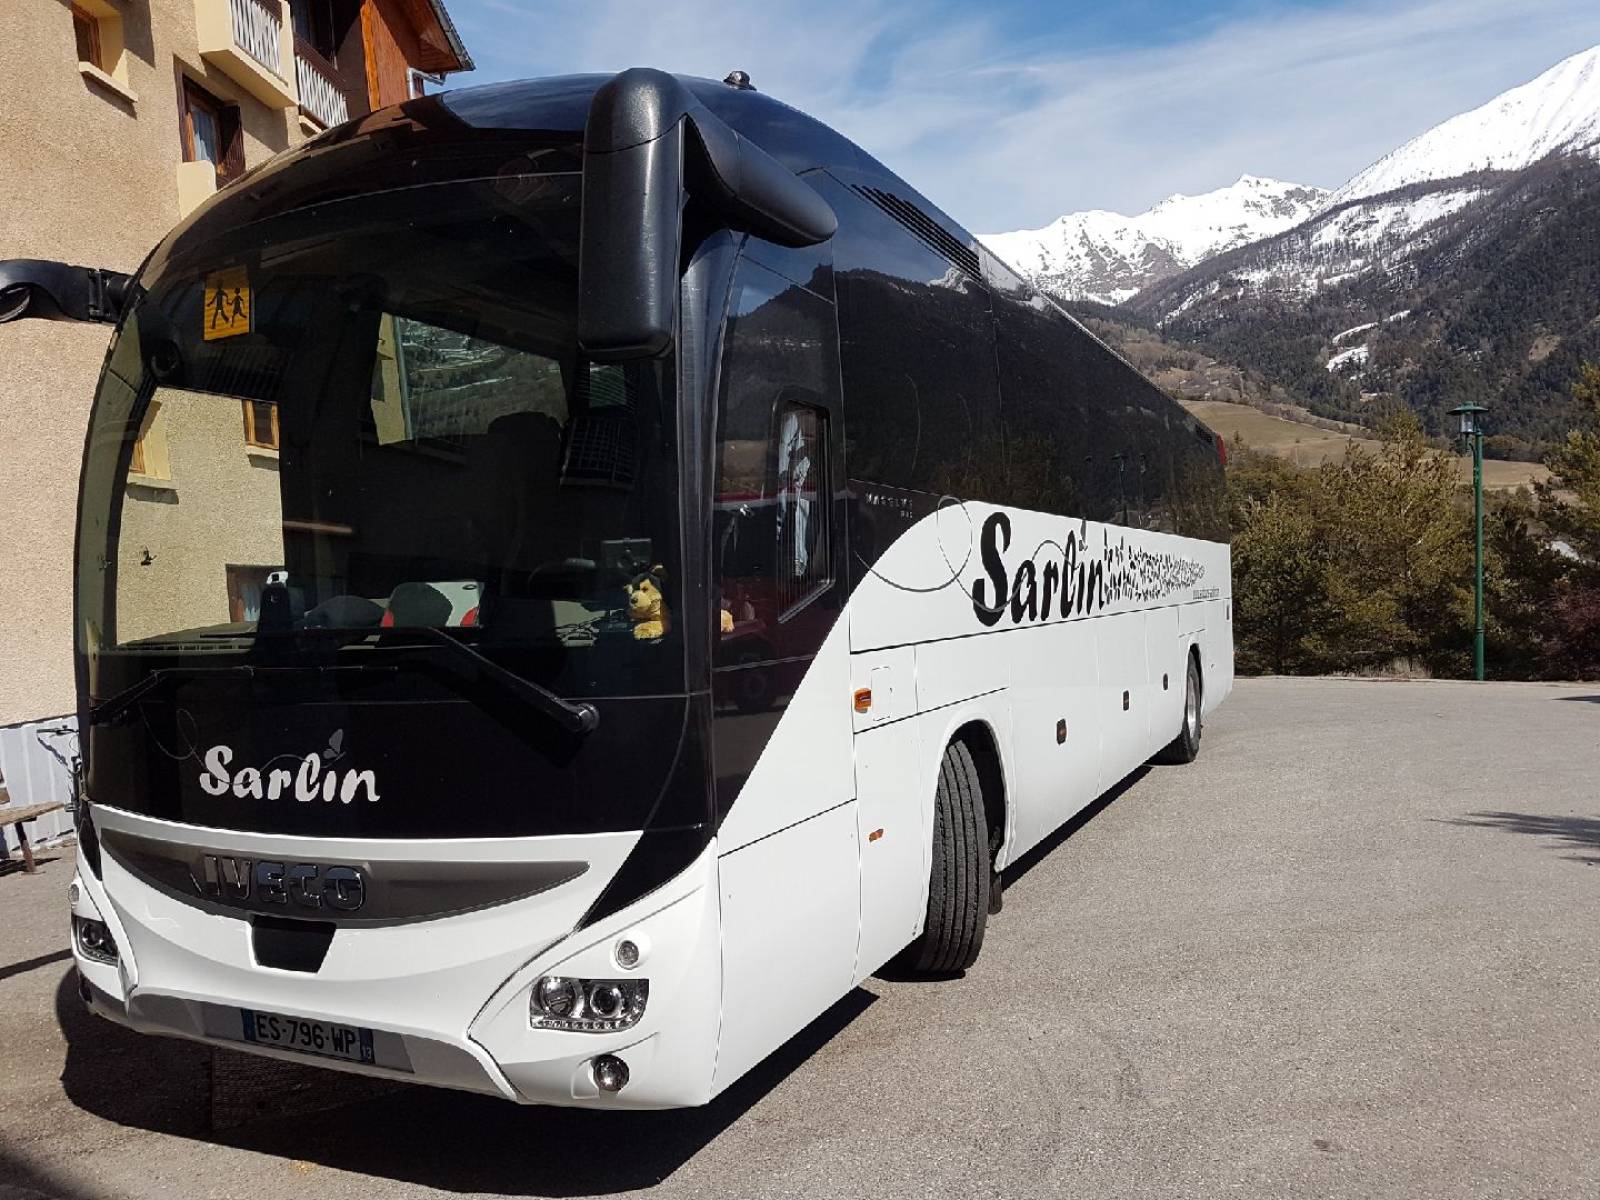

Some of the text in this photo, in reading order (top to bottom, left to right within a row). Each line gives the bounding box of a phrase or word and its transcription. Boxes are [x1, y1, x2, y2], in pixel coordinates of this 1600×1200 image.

[972, 512, 1104, 627] Sarlin
[199, 745, 380, 804] Sarlin
[203, 855, 366, 911] IVECO
